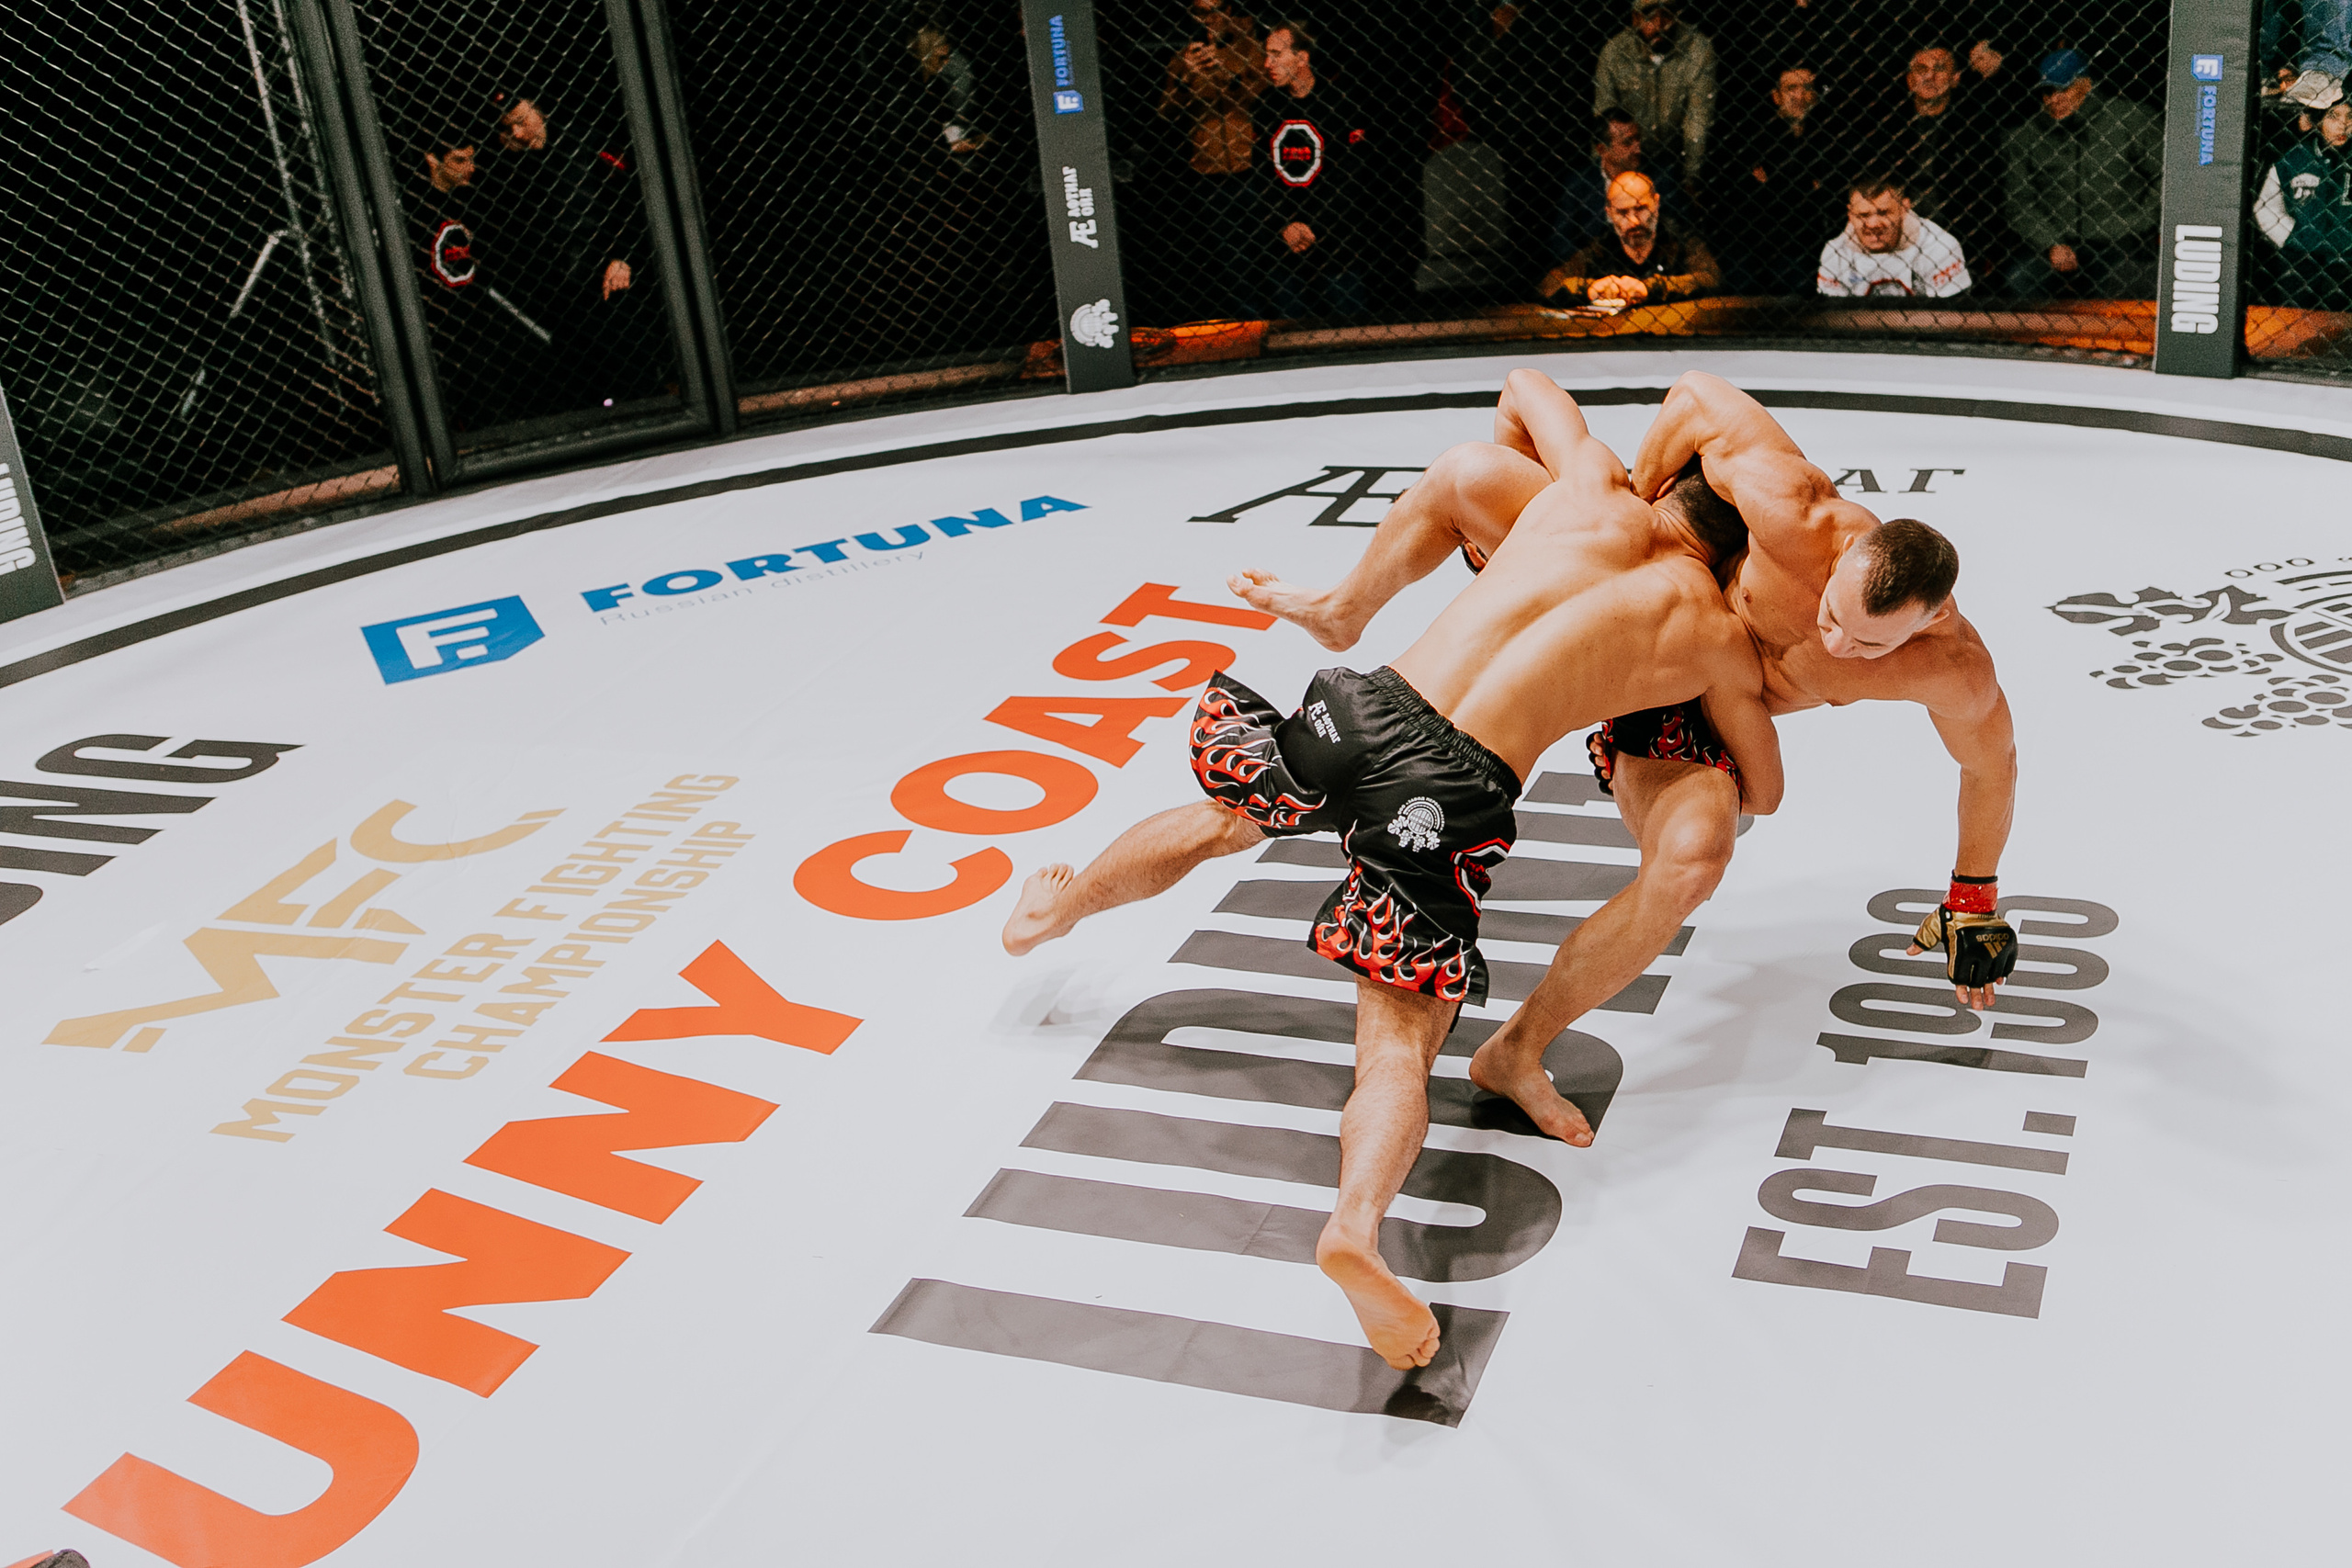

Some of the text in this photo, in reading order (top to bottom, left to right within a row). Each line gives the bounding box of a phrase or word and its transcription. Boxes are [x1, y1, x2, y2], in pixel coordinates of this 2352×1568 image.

[2199, 85, 2218, 166] FORTUNA
[2171, 224, 2222, 334] LUDING
[581, 494, 1091, 614] FORTUNA
[600, 550, 925, 626] Russian distillery
[40, 798, 568, 1054] MFC
[209, 773, 741, 1144] MONSTER FIGHTING
[401, 818, 758, 1081] CHAMPIONSHIP
[1975, 932, 2009, 943] adidas
[59, 581, 1279, 1568] UNNY COAST
[1731, 1107, 2078, 1320] EST.
